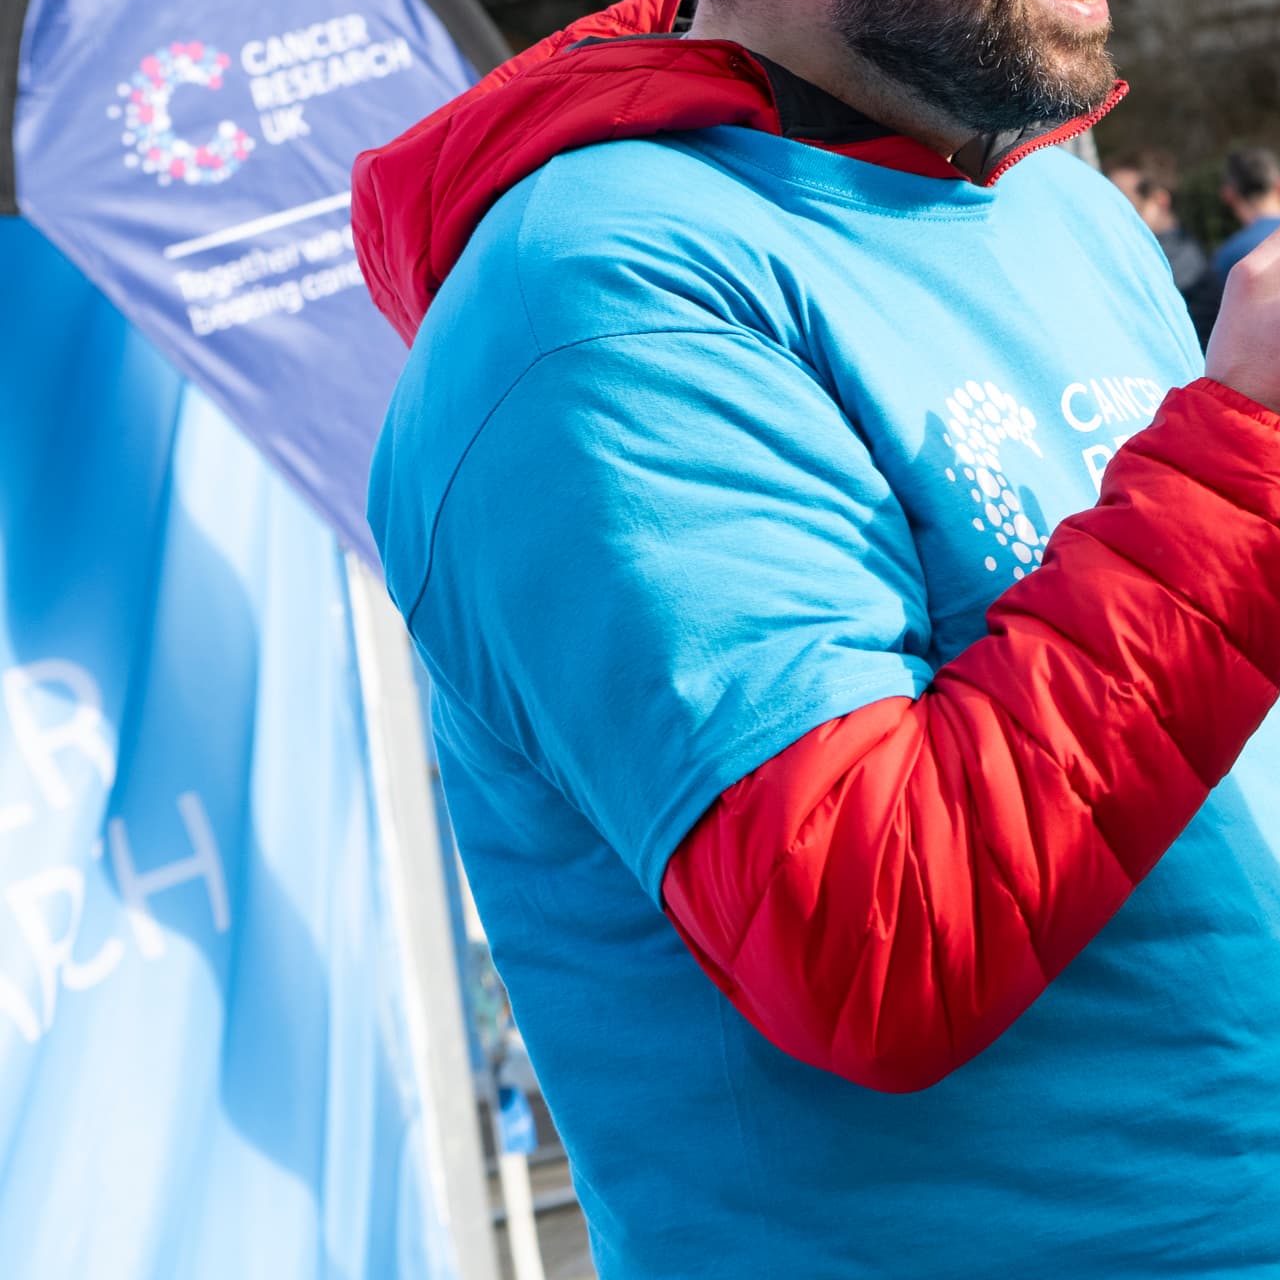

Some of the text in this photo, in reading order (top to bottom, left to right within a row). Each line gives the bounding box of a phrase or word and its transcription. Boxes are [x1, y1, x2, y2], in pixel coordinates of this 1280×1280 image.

[240, 14, 369, 76] CANCER
[250, 38, 412, 111] RESEARCH
[260, 103, 311, 144] UK
